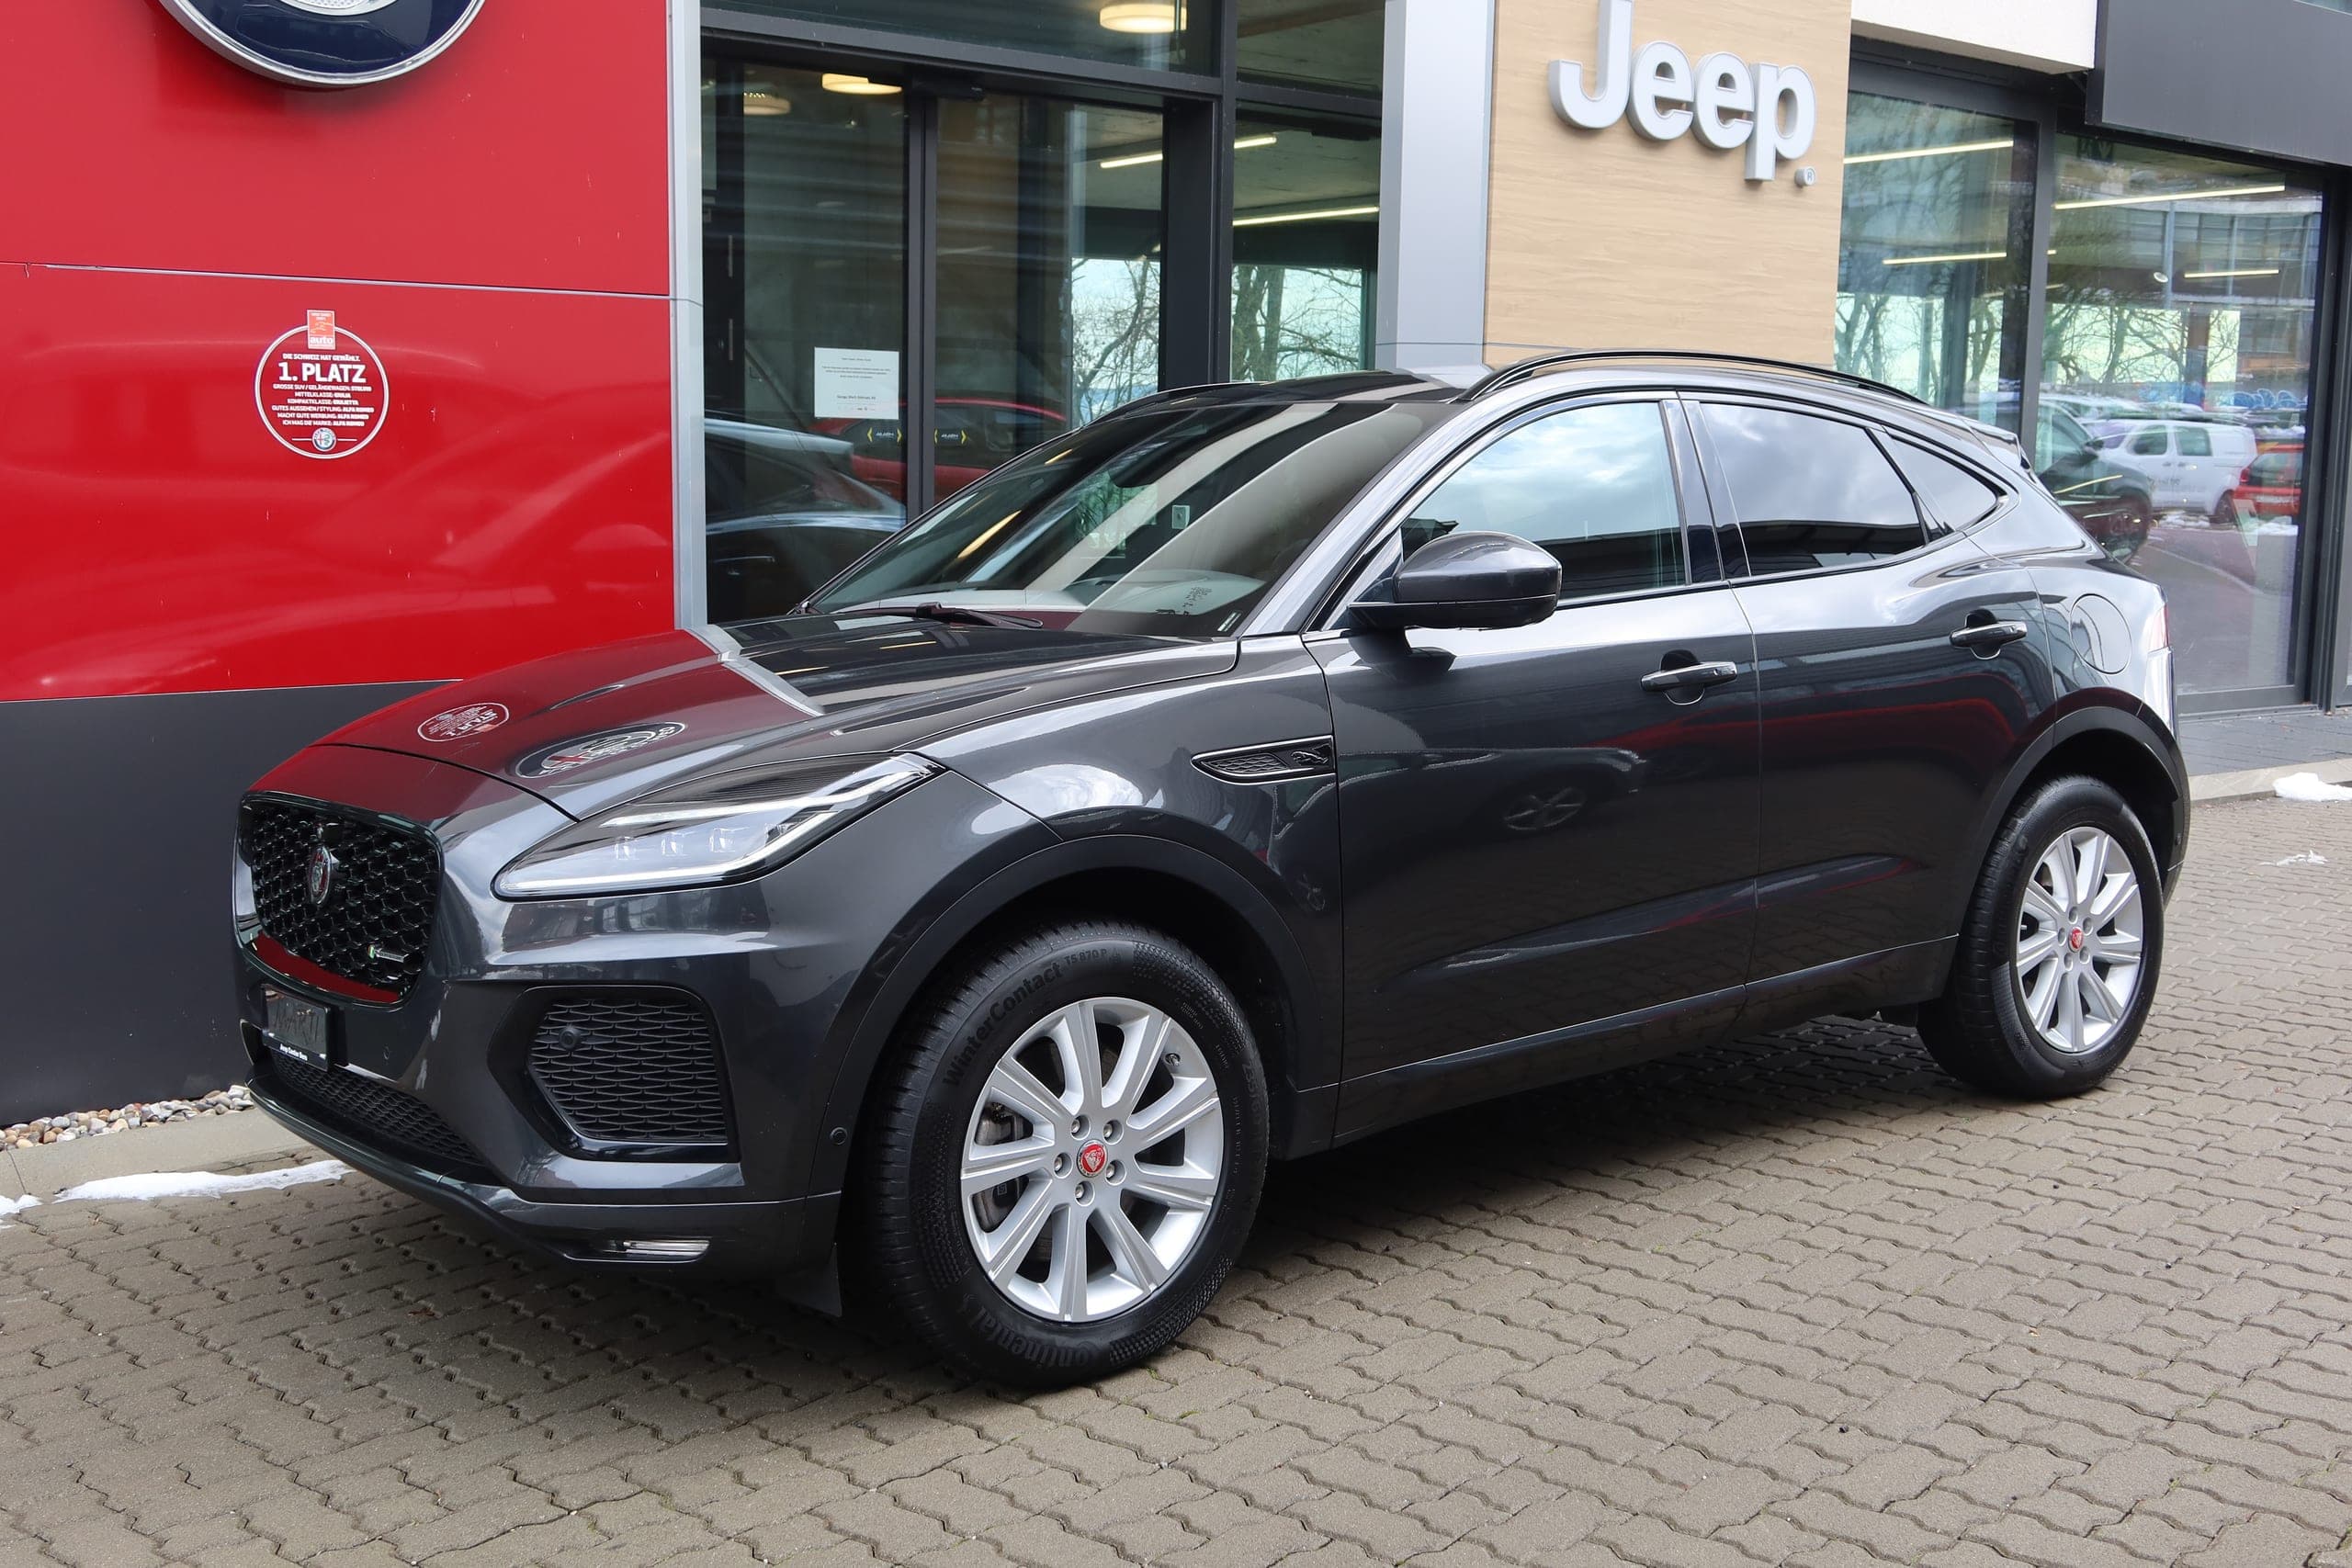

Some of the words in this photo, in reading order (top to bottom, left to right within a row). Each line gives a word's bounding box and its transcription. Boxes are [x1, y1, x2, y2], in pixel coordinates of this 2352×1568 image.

[1548, 0, 1815, 181] Jeep
[278, 362, 299, 381] 1.
[301, 363, 367, 383] PLATZ
[943, 962, 1063, 1088] WinterContact
